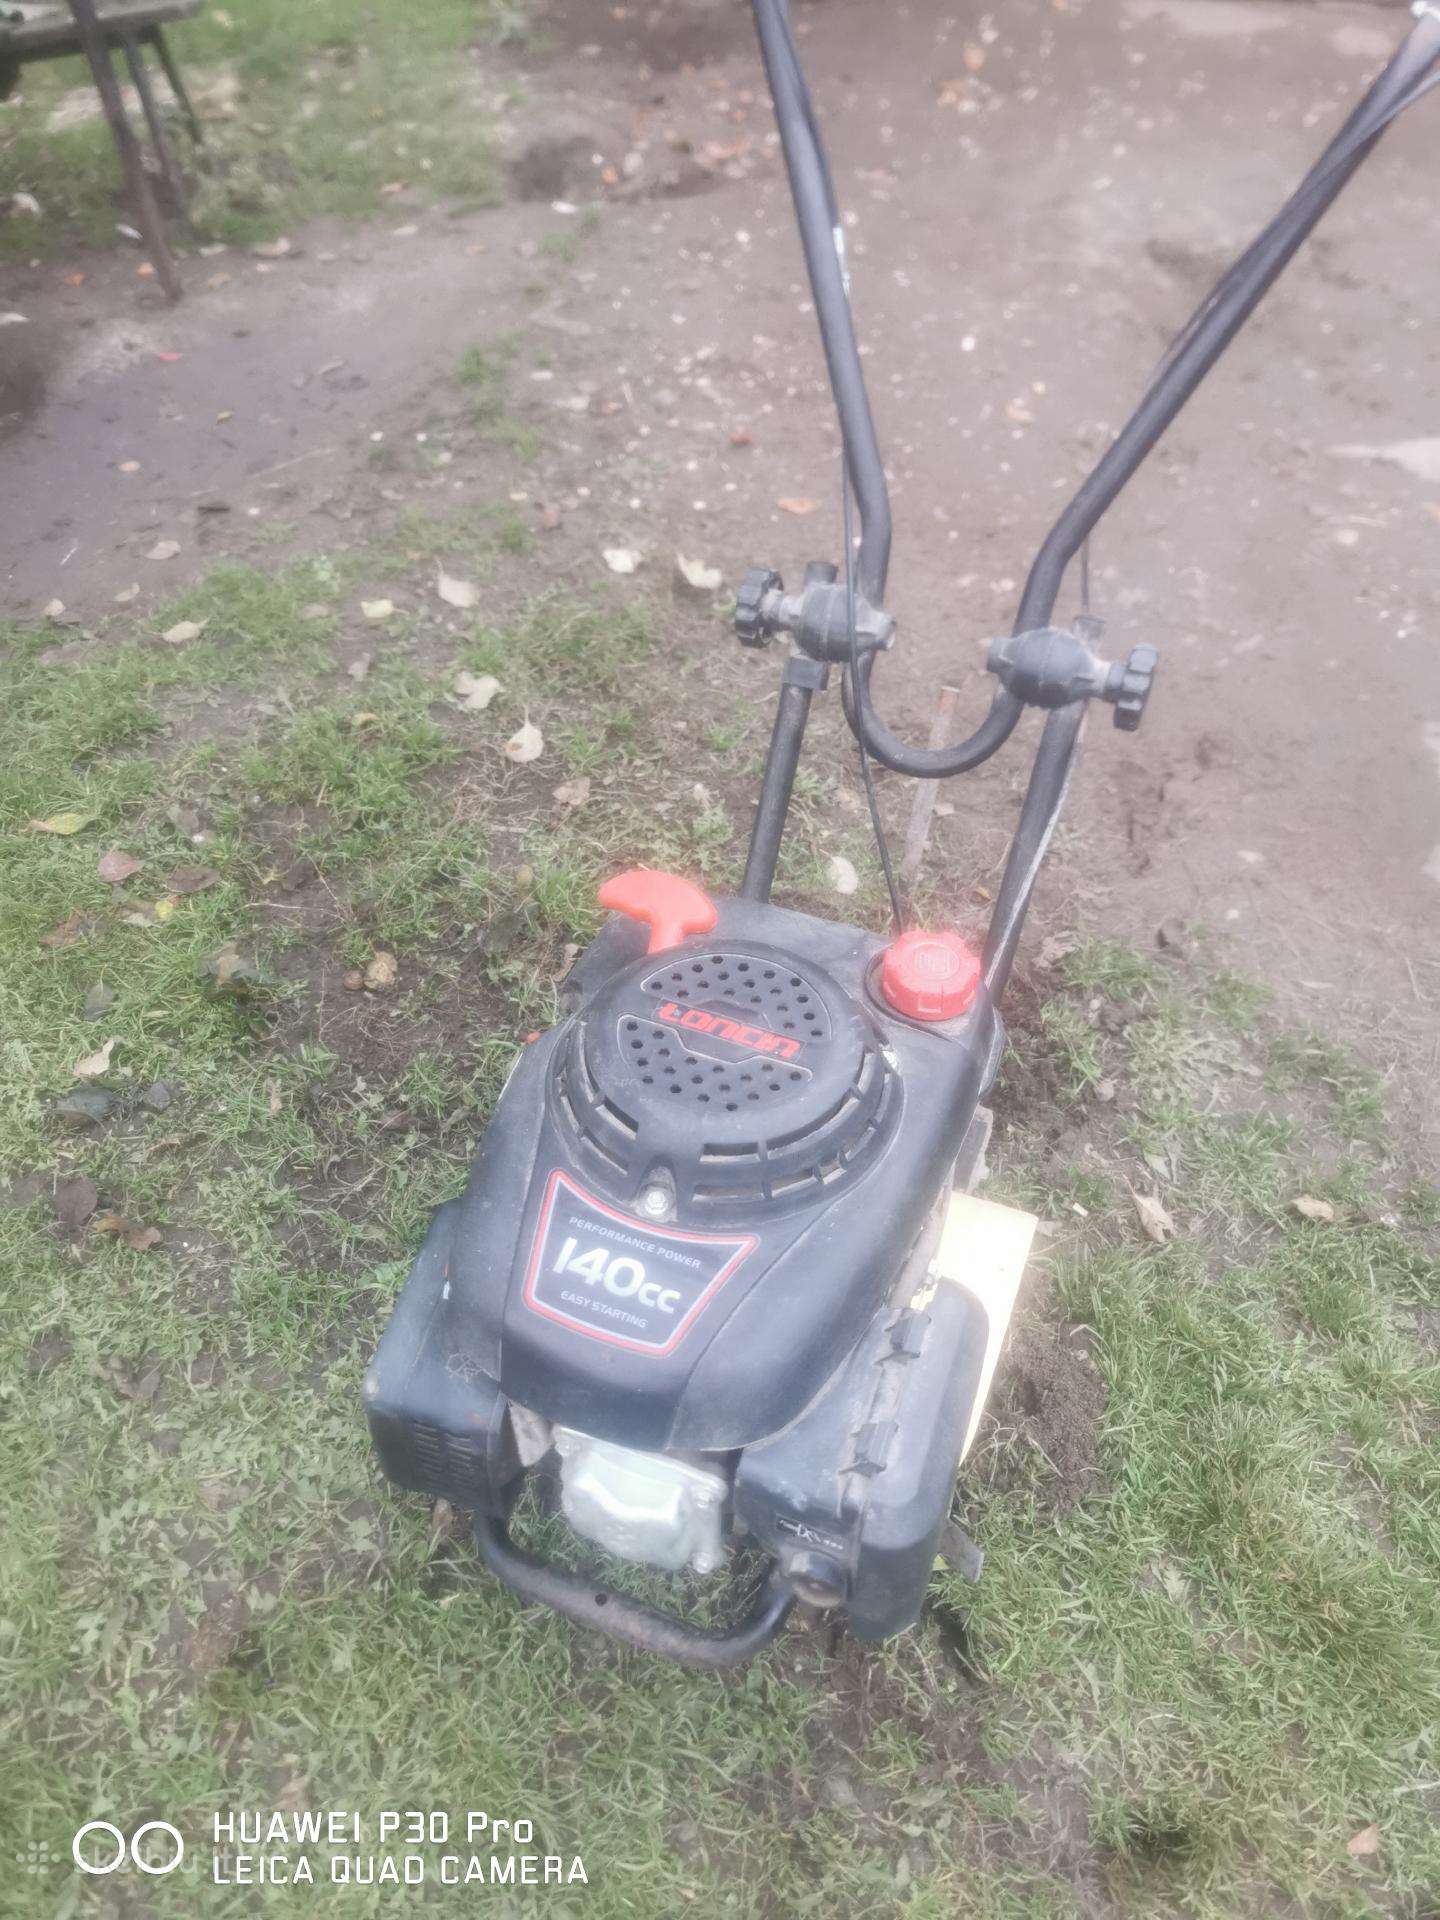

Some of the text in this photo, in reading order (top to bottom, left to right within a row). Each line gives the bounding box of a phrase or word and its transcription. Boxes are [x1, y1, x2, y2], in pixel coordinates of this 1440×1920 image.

[568, 1216, 702, 1270] PERFORMANCE POWER
[552, 1236, 682, 1315] 140cc
[560, 1289, 649, 1329] EASY STARTING
